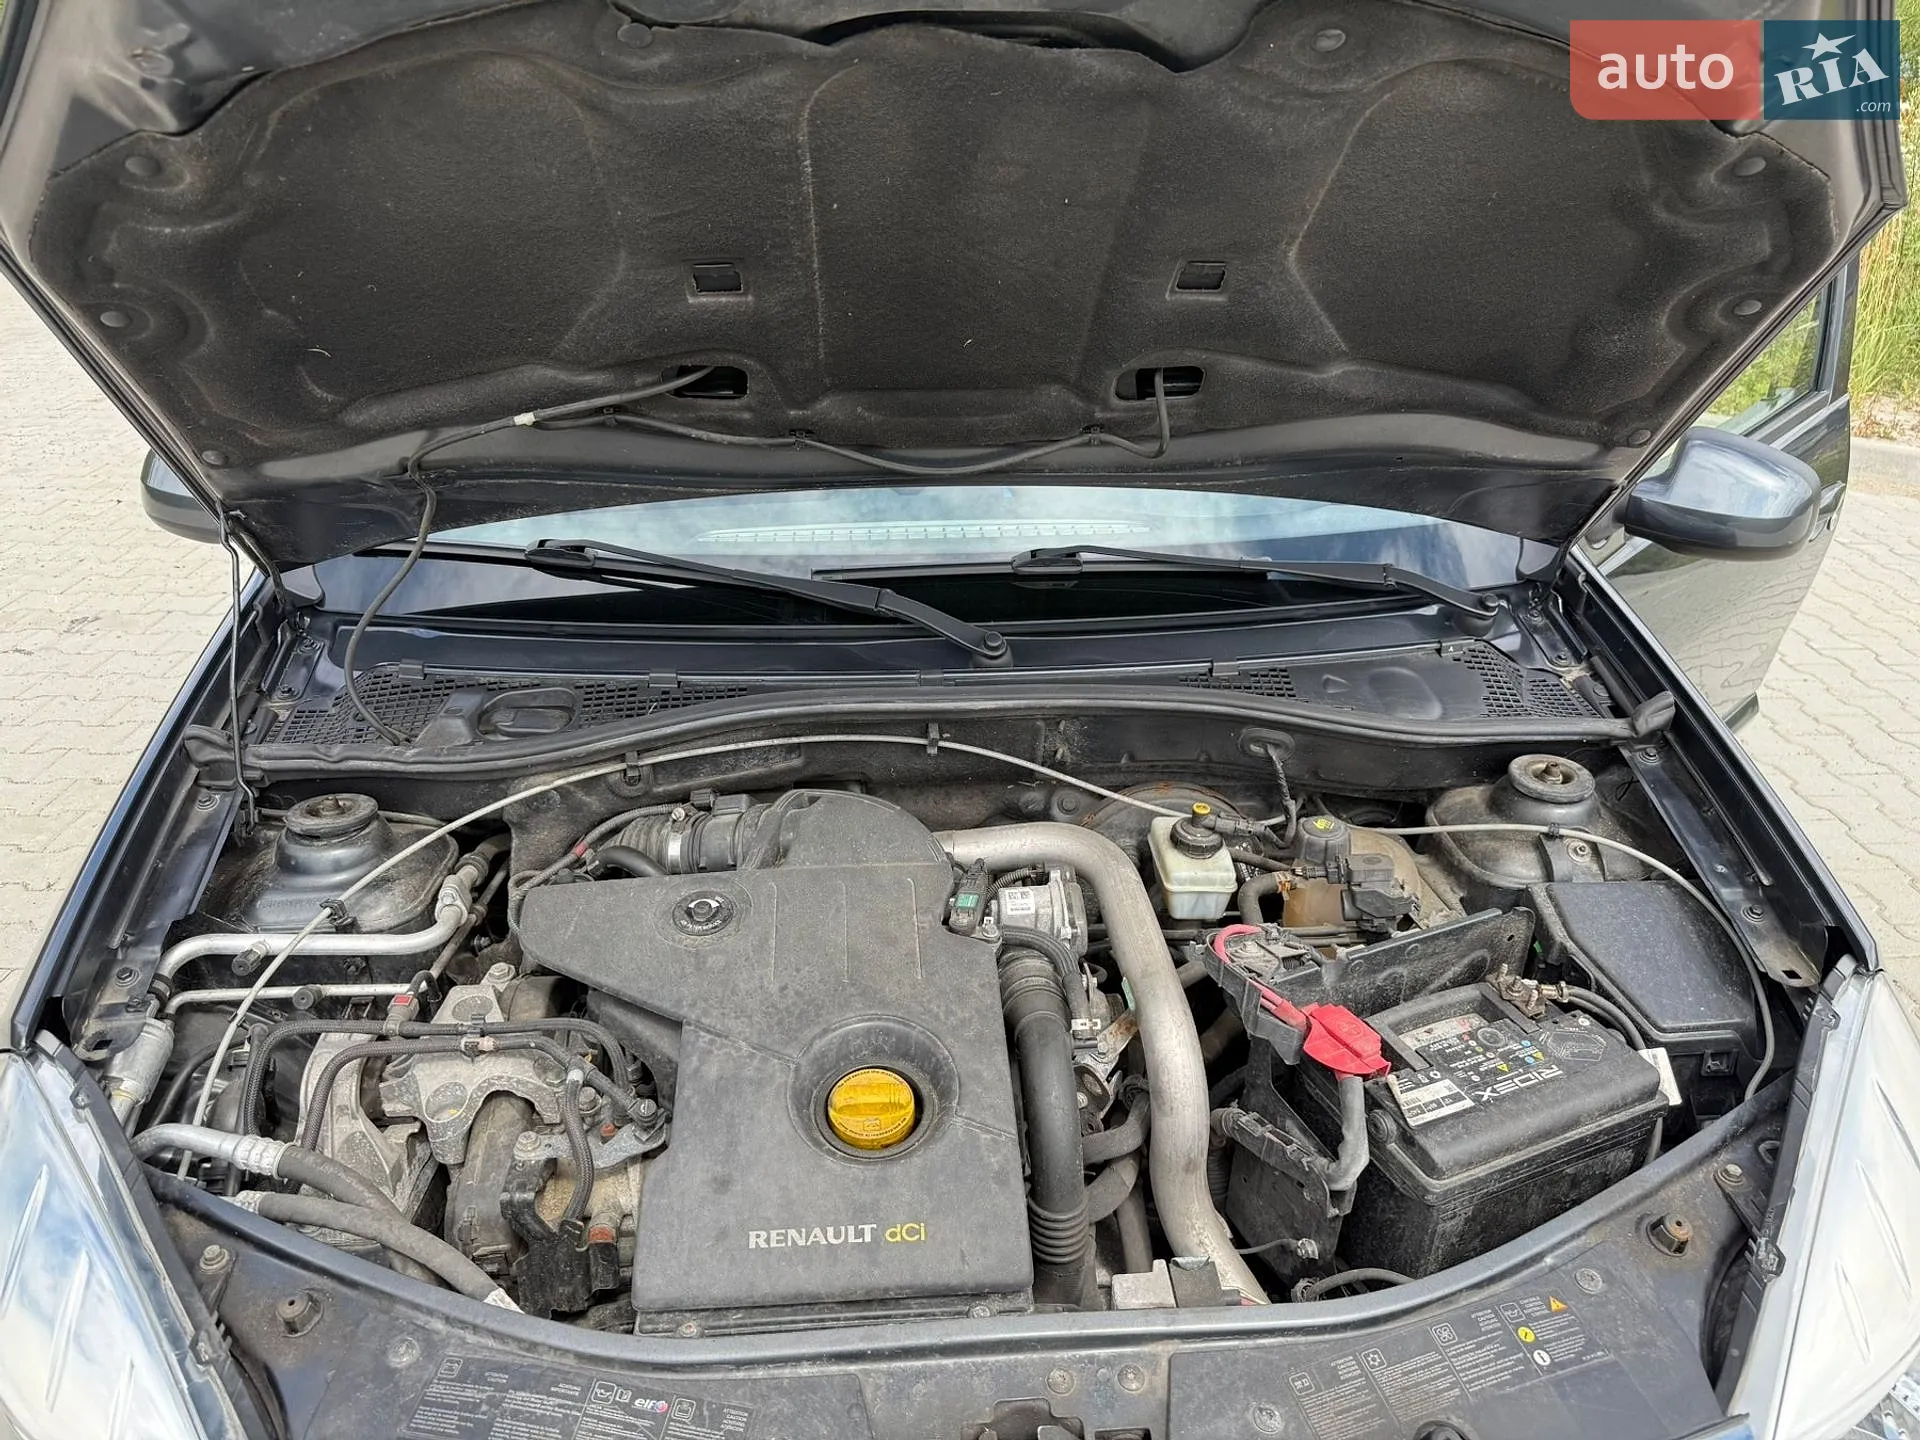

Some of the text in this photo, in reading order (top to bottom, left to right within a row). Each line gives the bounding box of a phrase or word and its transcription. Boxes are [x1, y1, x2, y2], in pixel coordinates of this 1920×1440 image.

[1473, 1064, 1563, 1102] RIDEX
[749, 1222, 926, 1249] RENAULT dCi
